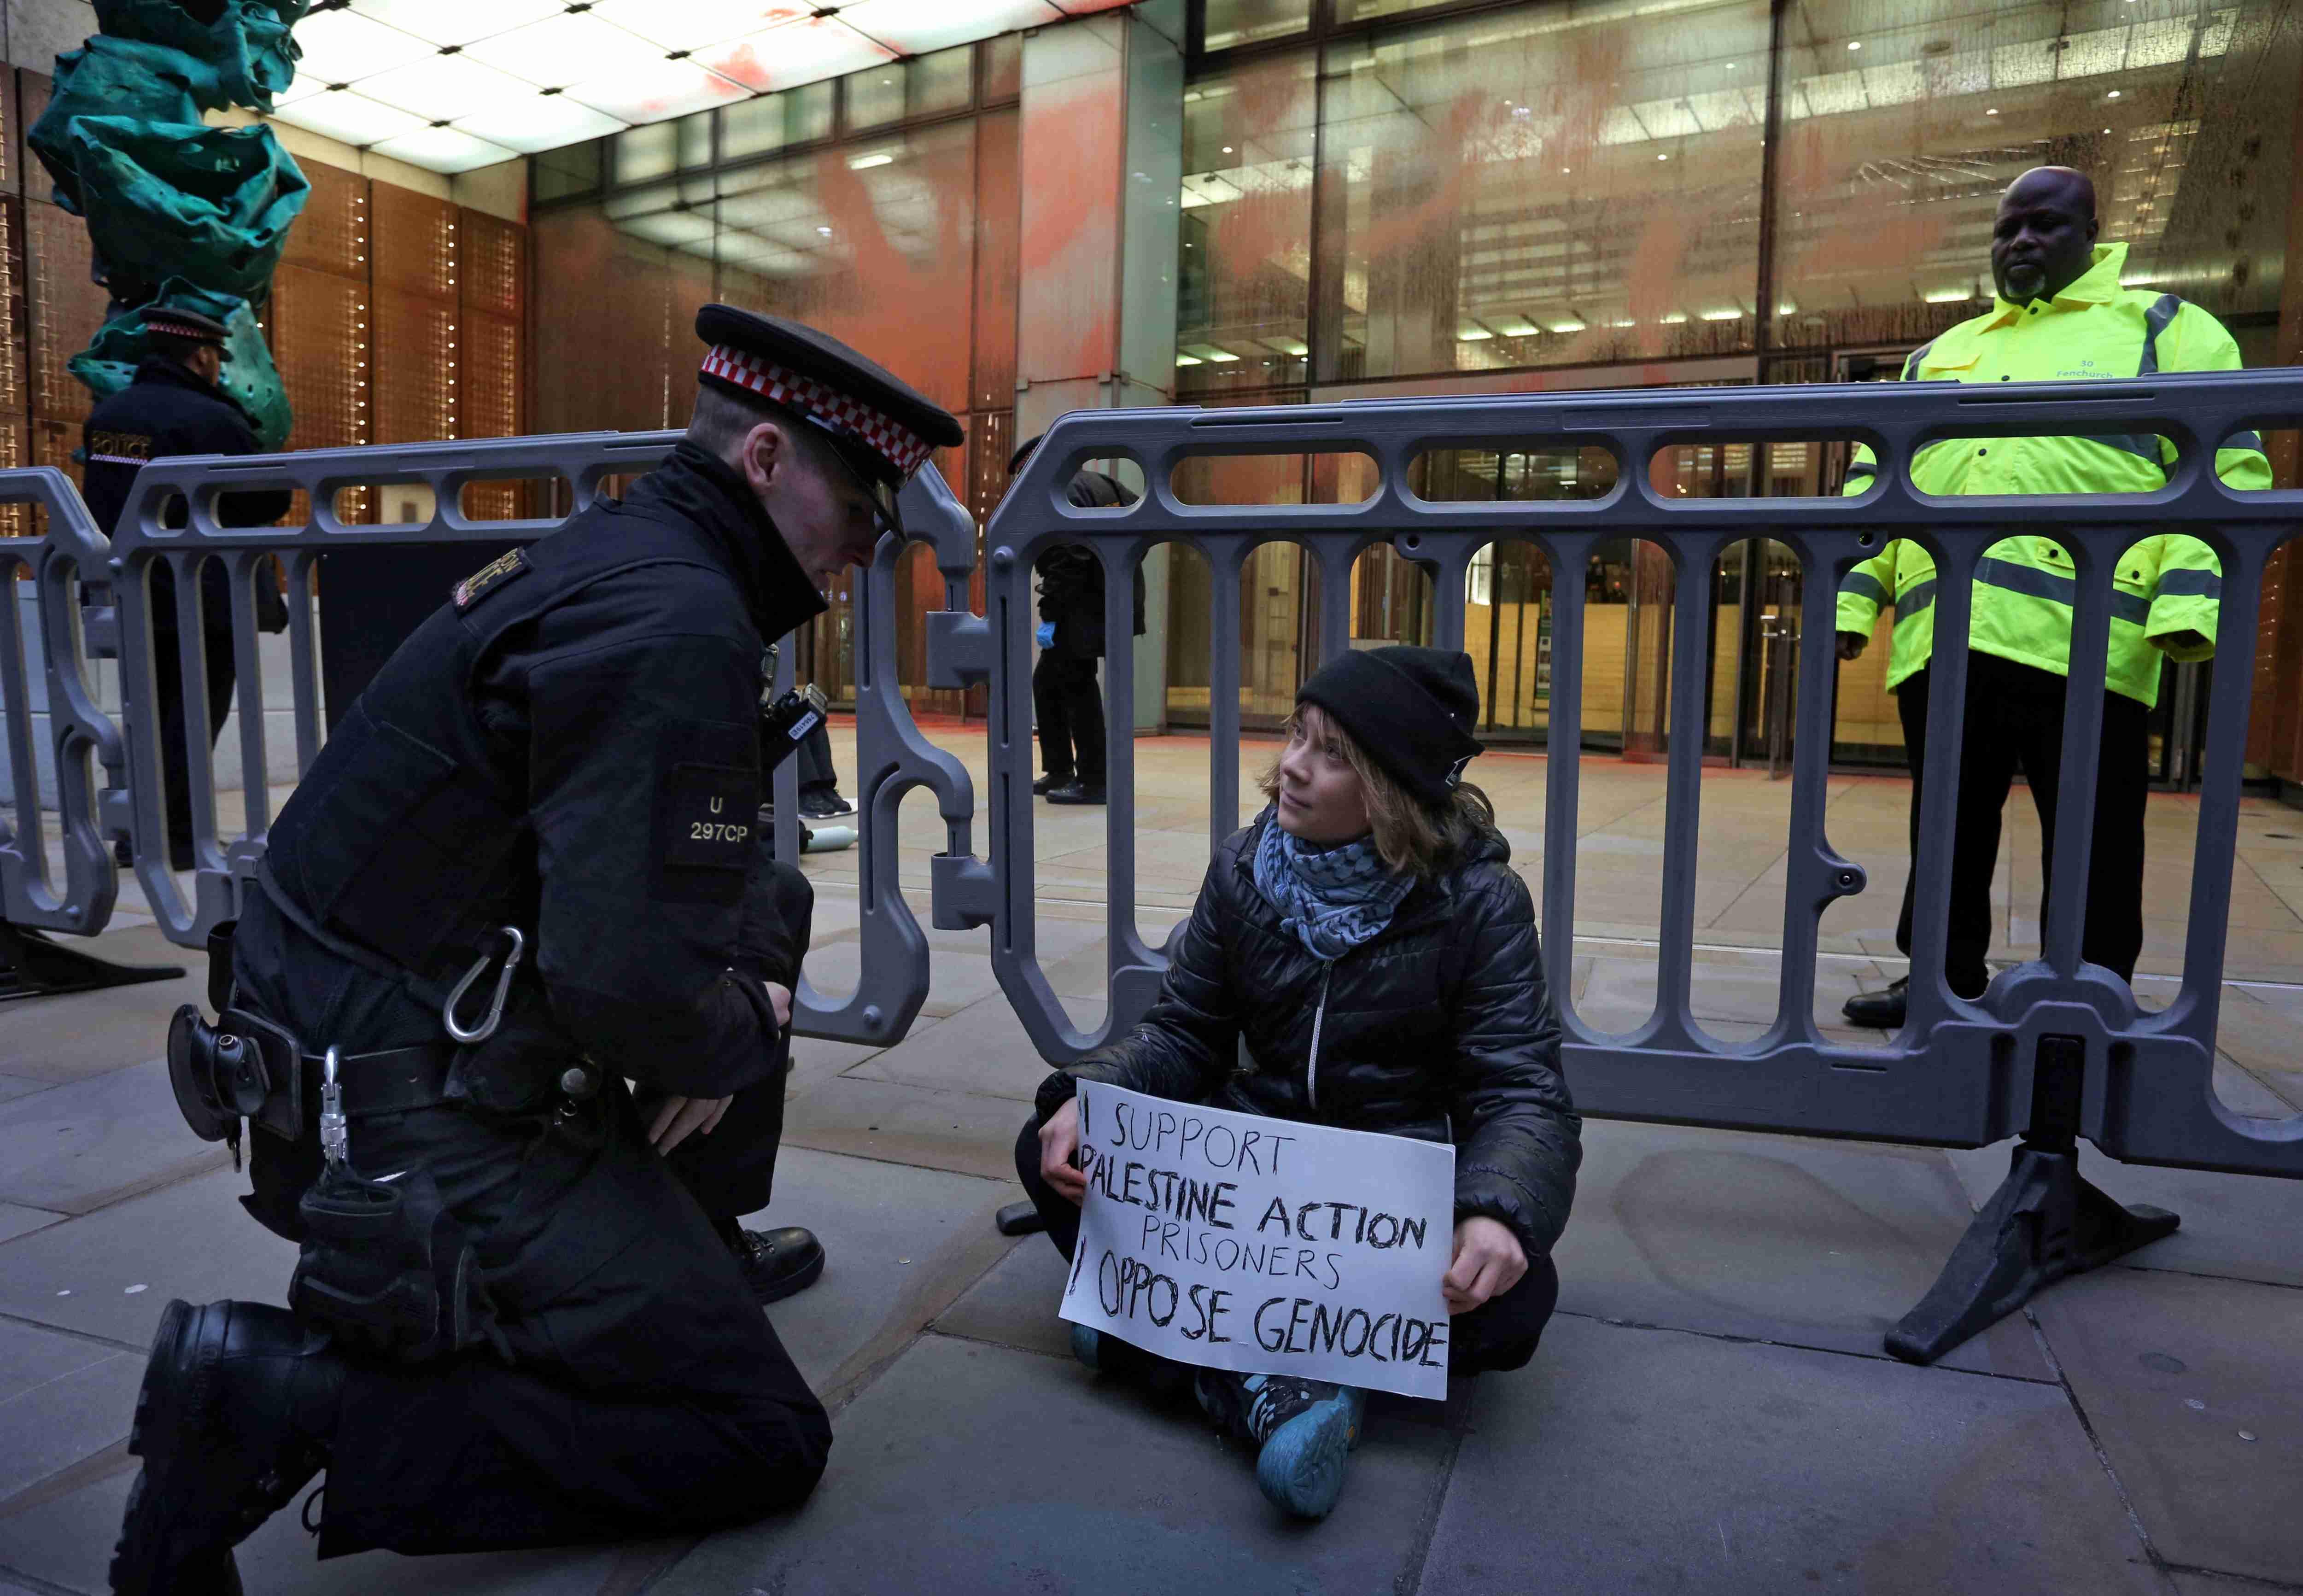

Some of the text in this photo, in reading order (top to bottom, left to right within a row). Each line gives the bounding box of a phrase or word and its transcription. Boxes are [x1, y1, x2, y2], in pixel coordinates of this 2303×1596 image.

[2056, 370, 2113, 378] Fenchurch
[91, 437, 150, 457] POLICE
[710, 796, 723, 813] U
[690, 822, 748, 843] 297CP
[1111, 1103, 1295, 1175] SUPPORT
[1080, 1144, 1427, 1249] PALESTINE ACTION
[1142, 1215, 1343, 1290] PRISONERS
[1069, 1234, 1449, 1367] I OPPOSE GENOCIDE
